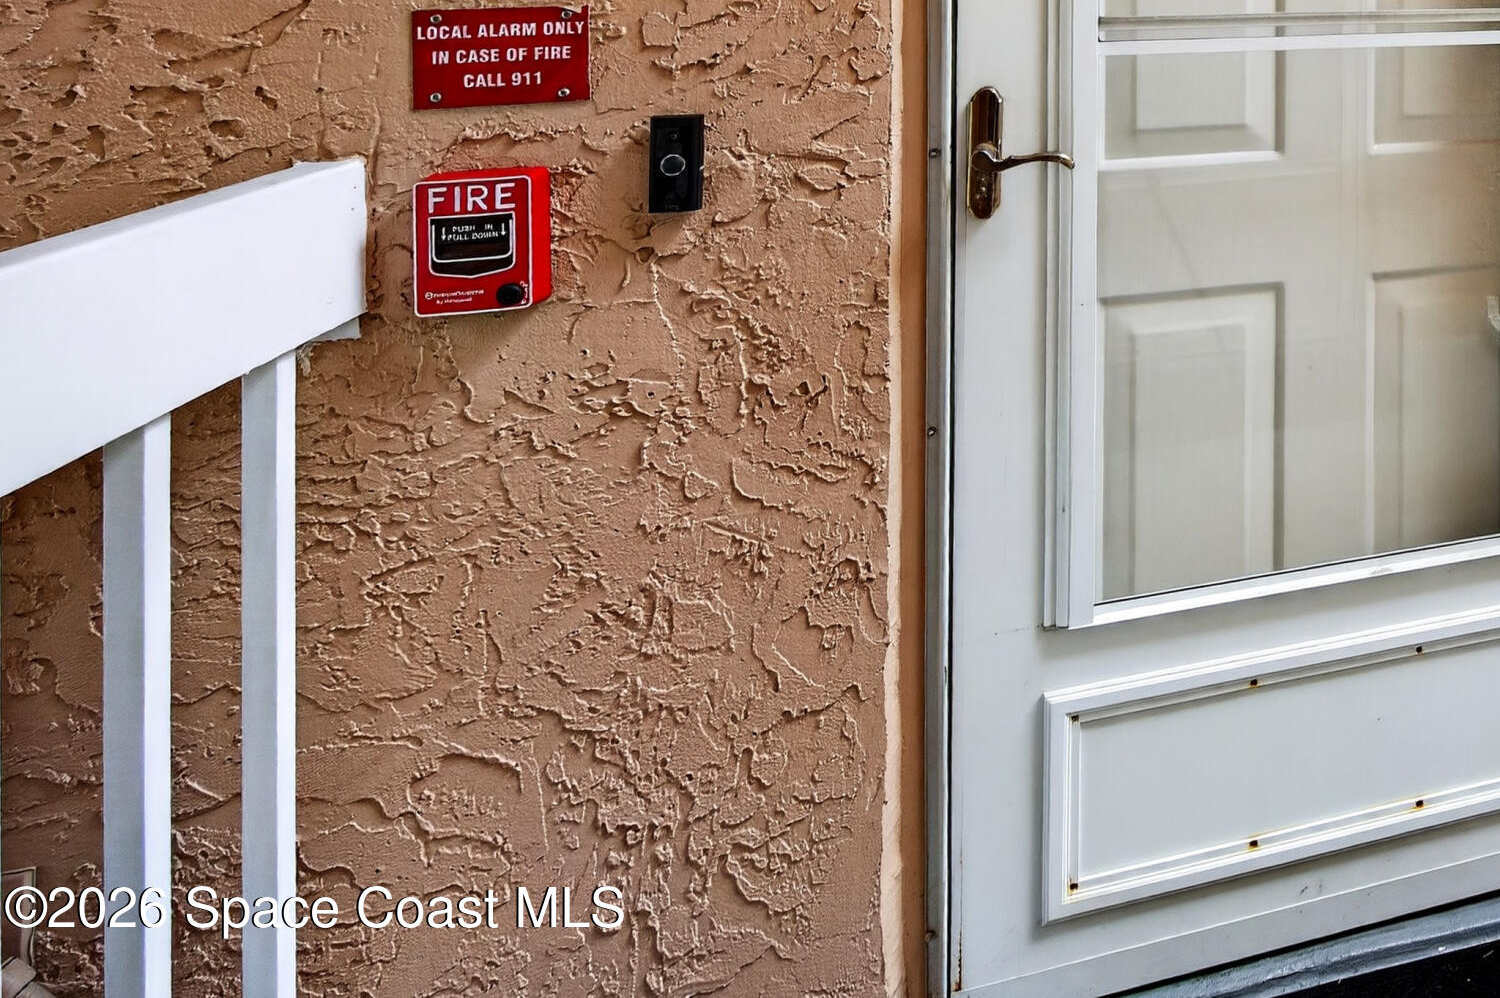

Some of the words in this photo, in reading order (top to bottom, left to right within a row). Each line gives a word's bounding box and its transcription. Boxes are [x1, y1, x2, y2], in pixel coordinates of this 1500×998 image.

[416, 25, 472, 40] LOCAL
[477, 22, 537, 38] ALARM
[543, 21, 585, 36] ONLY
[431, 50, 449, 65] IN
[456, 48, 500, 64] CASE
[506, 47, 528, 62] OF
[534, 45, 572, 60] FIRE
[463, 73, 506, 88] CALL
[511, 71, 542, 86] 911
[427, 182, 516, 213] FIRE
[447, 233, 469, 241] PULL
[452, 225, 476, 233] PUSH
[484, 223, 493, 231] IN
